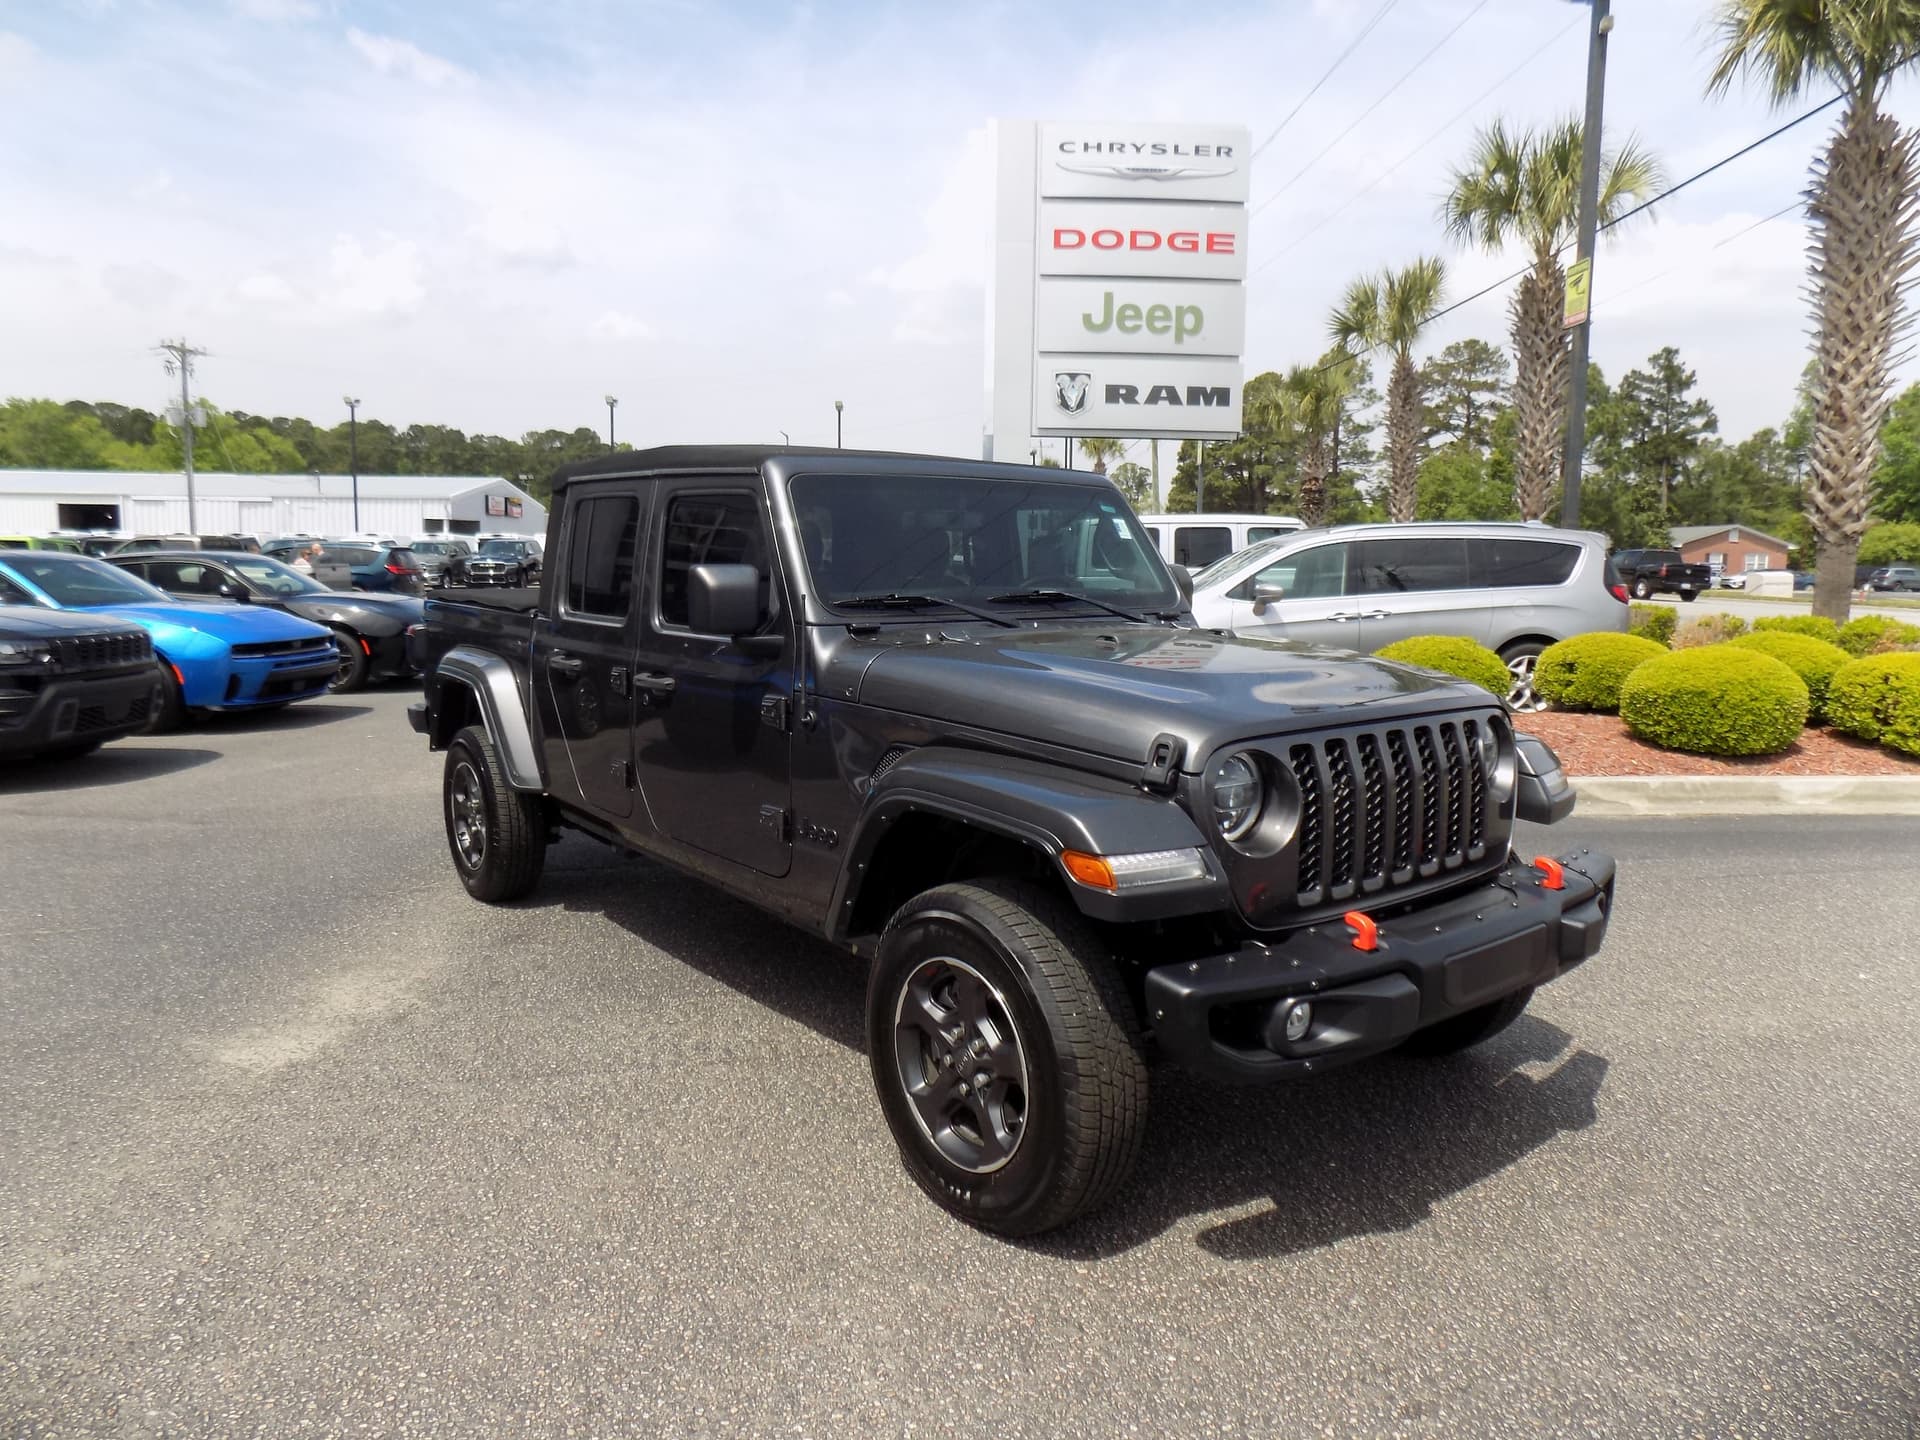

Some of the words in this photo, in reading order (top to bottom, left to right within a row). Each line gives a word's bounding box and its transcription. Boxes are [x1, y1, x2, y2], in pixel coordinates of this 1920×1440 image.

[1059, 141, 1233, 158] CHRYSLER
[1053, 229, 1235, 254] DODGE
[1082, 291, 1204, 344] Jeep
[1104, 384, 1231, 407] RAM
